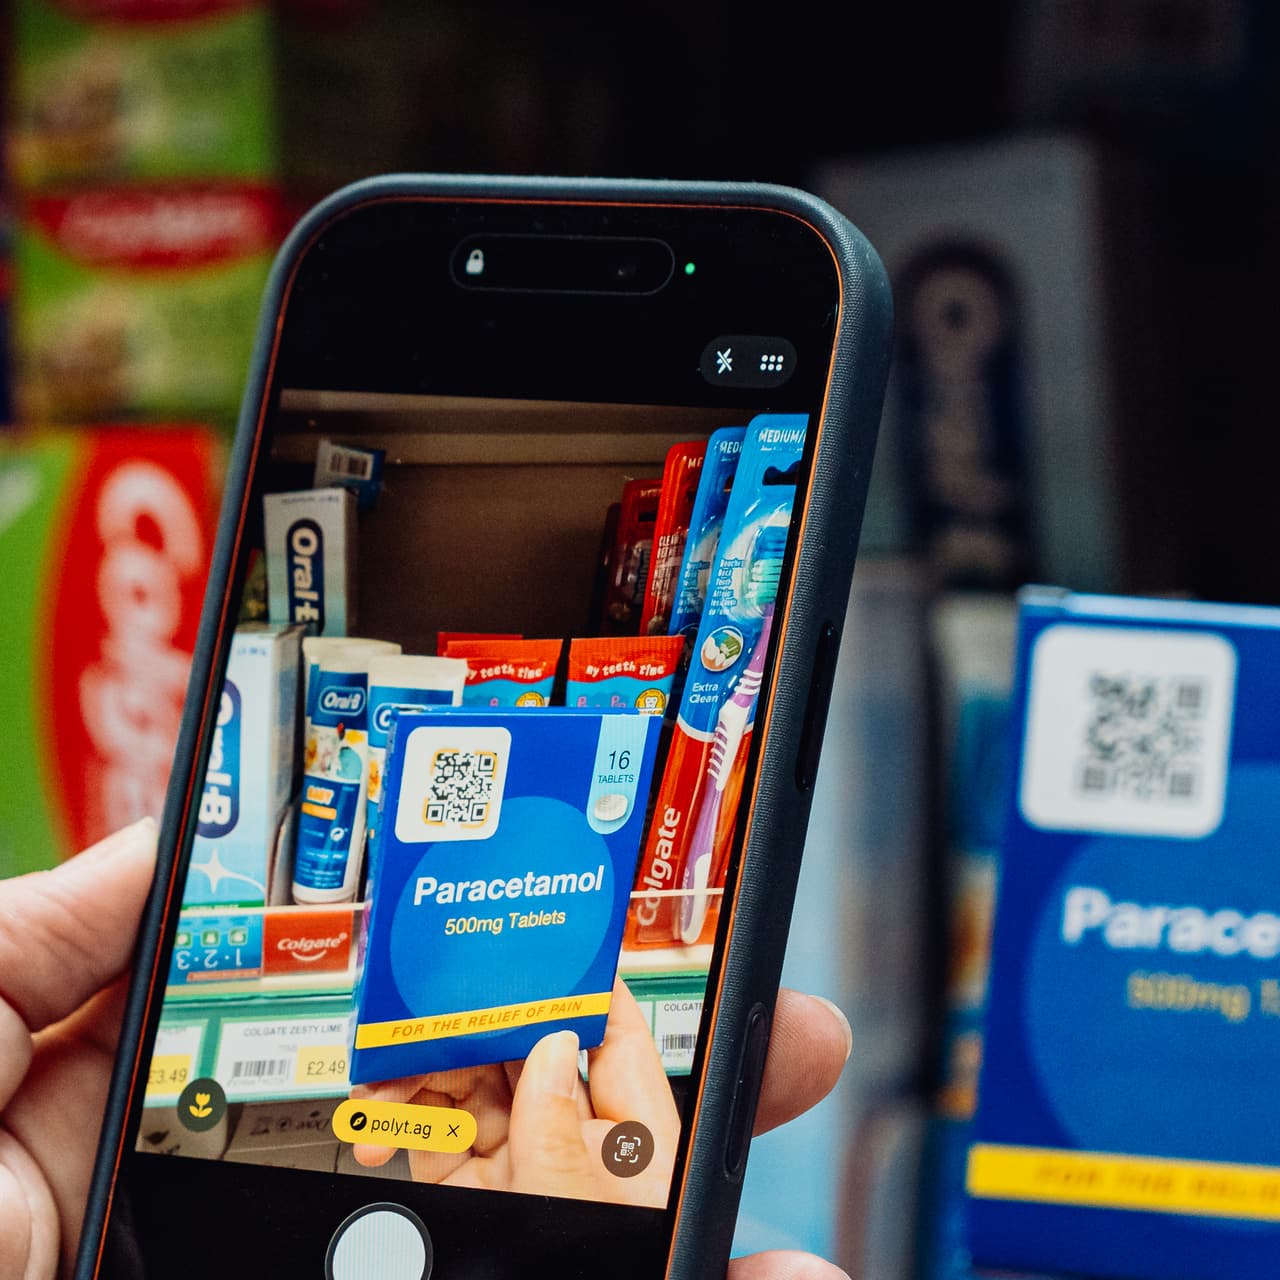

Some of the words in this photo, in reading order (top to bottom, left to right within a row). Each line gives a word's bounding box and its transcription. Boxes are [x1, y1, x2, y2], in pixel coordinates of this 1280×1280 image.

[602, 660, 636, 676] teeth
[692, 682, 719, 692] Extra
[689, 693, 719, 704] Clean
[608, 749, 632, 770] 16
[598, 773, 635, 784] TABLETS
[636, 804, 681, 927] Colgate
[413, 864, 605, 906] Paracetamol
[444, 916, 503, 936] 500mg
[509, 909, 567, 929] Tablets
[277, 934, 342, 952] Colgate
[392, 1023, 425, 1038] FOR
[433, 1018, 464, 1033] THE
[467, 1009, 522, 1029] RELIEF
[526, 1005, 547, 1019] OF
[550, 1000, 583, 1014] PAIN
[243, 1025, 287, 1037] COLGATE
[289, 1024, 319, 1035] ZESTY
[321, 1023, 343, 1033] LIME
[307, 1059, 346, 1076] £2.49
[371, 1117, 432, 1139] polyt.ag
